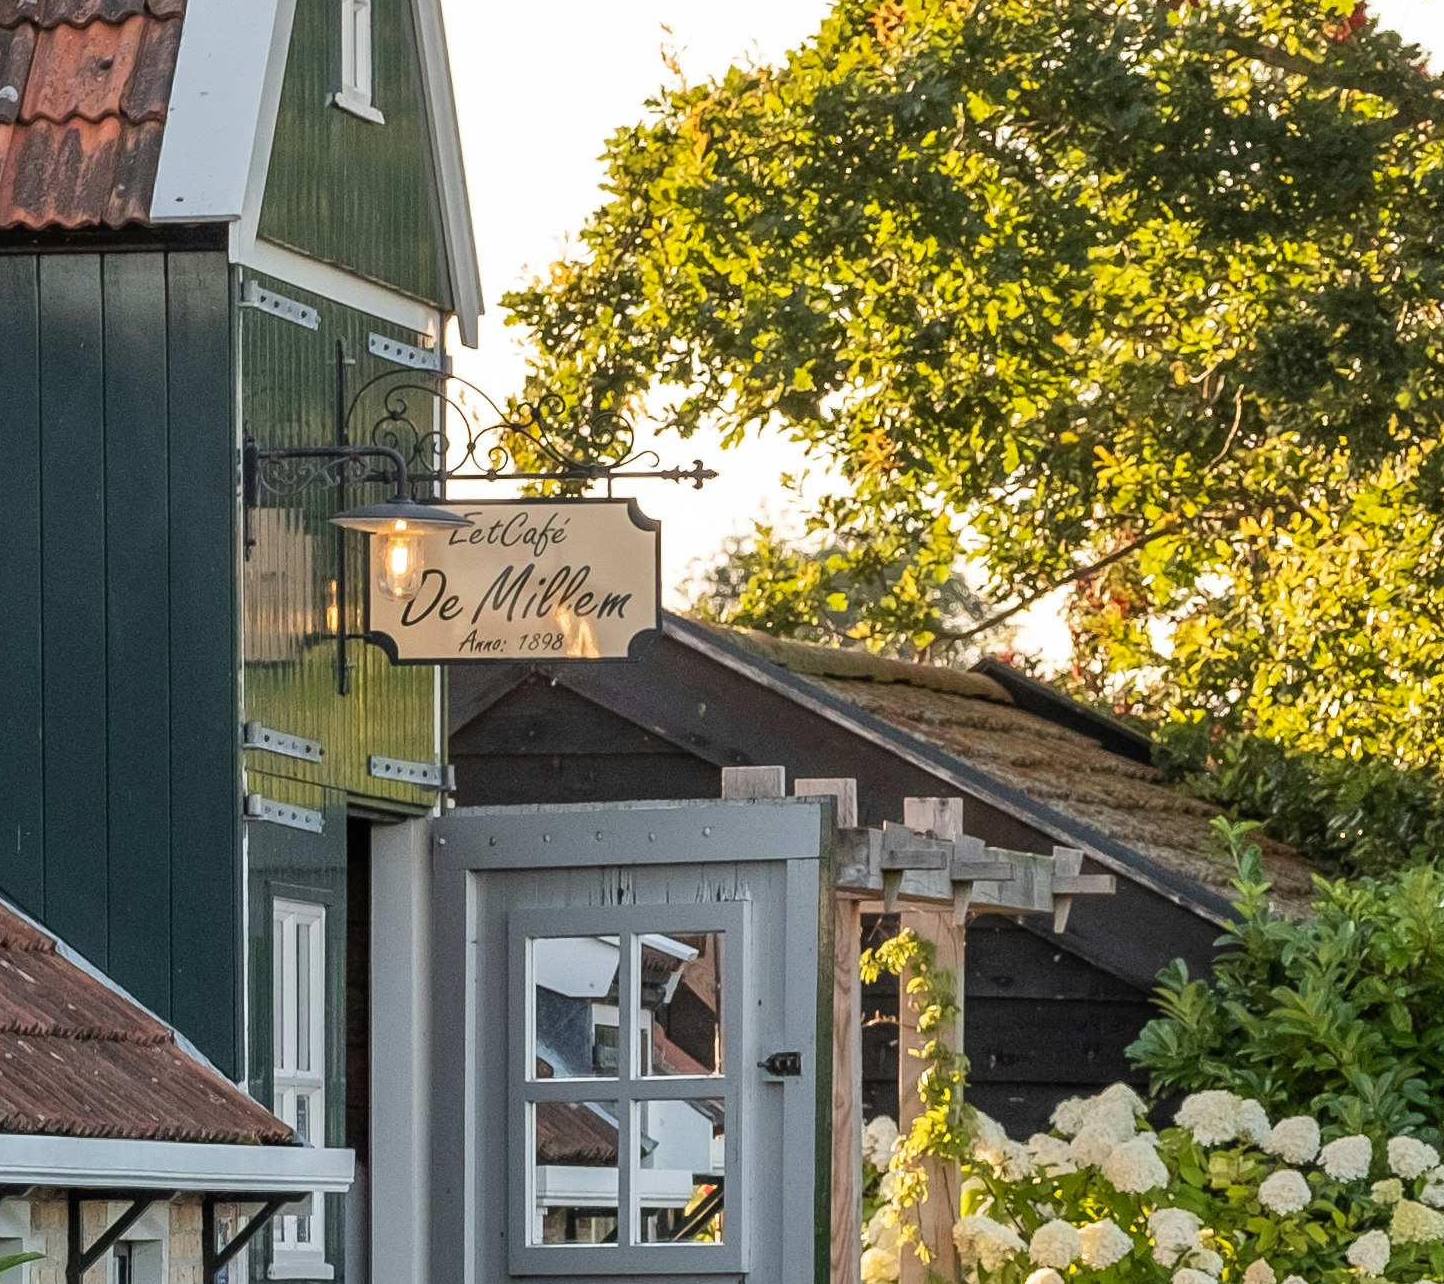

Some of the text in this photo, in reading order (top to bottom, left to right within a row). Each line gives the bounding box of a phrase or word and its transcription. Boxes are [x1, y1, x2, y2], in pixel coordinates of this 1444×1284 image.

[448, 511, 571, 558] EetCafé
[400, 563, 633, 627] De Millem
[458, 628, 565, 653] Anno: 1898
